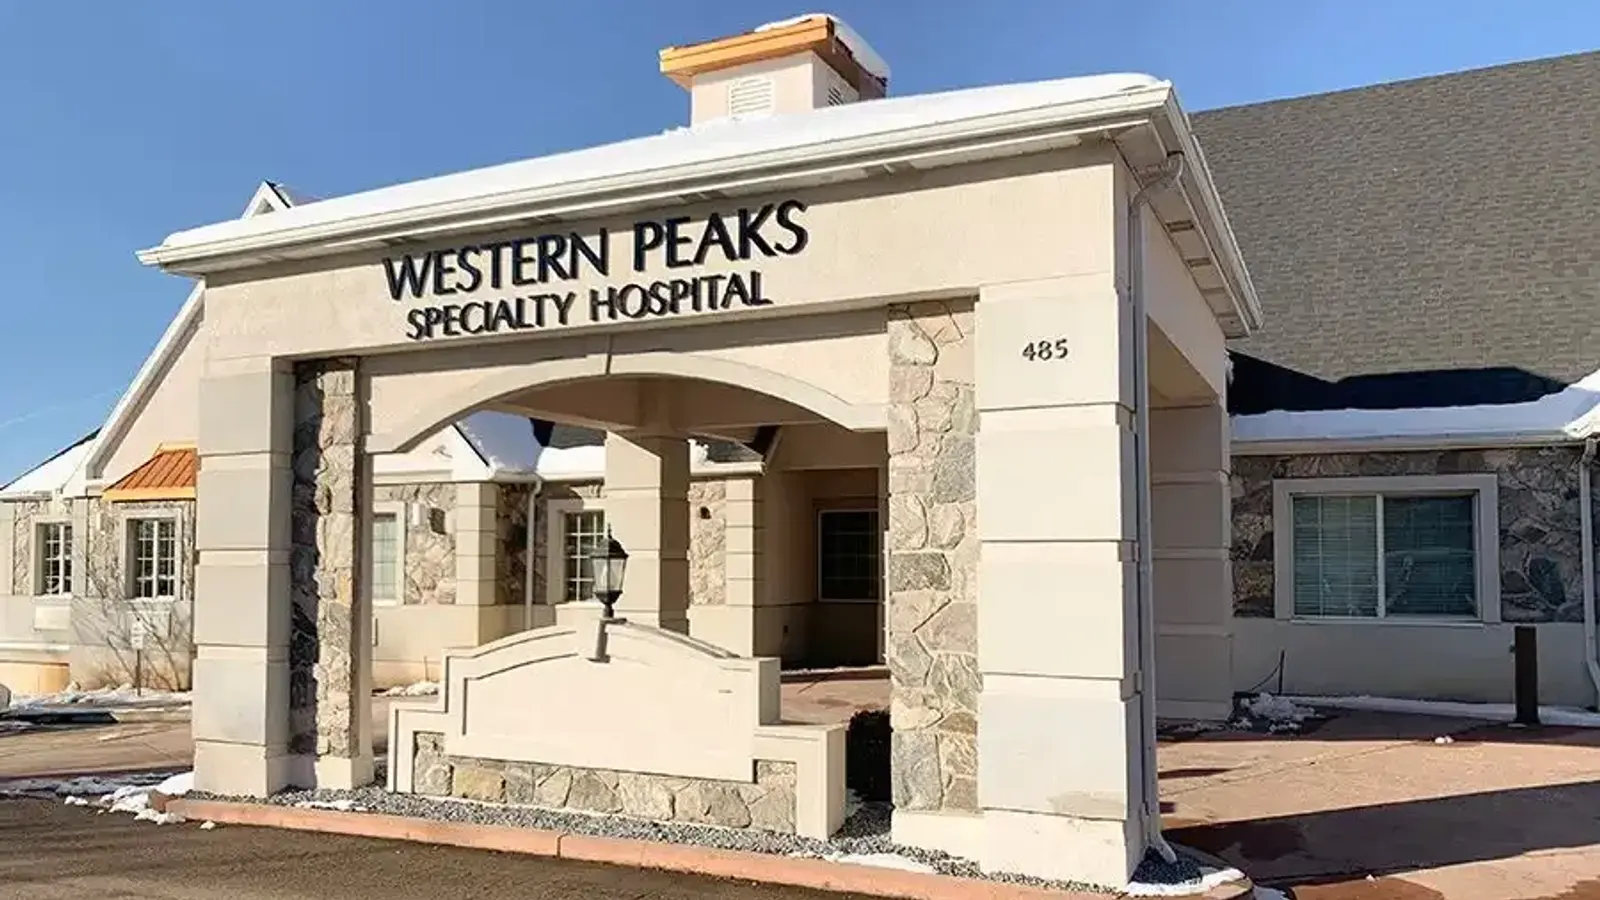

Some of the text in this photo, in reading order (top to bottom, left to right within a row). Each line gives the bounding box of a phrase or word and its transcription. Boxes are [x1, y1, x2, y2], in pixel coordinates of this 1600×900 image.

[382, 199, 809, 301] WESTERN PEAKS
[406, 270, 774, 340] SPECIALTY HOSPITAL
[1022, 338, 1069, 361] 485
